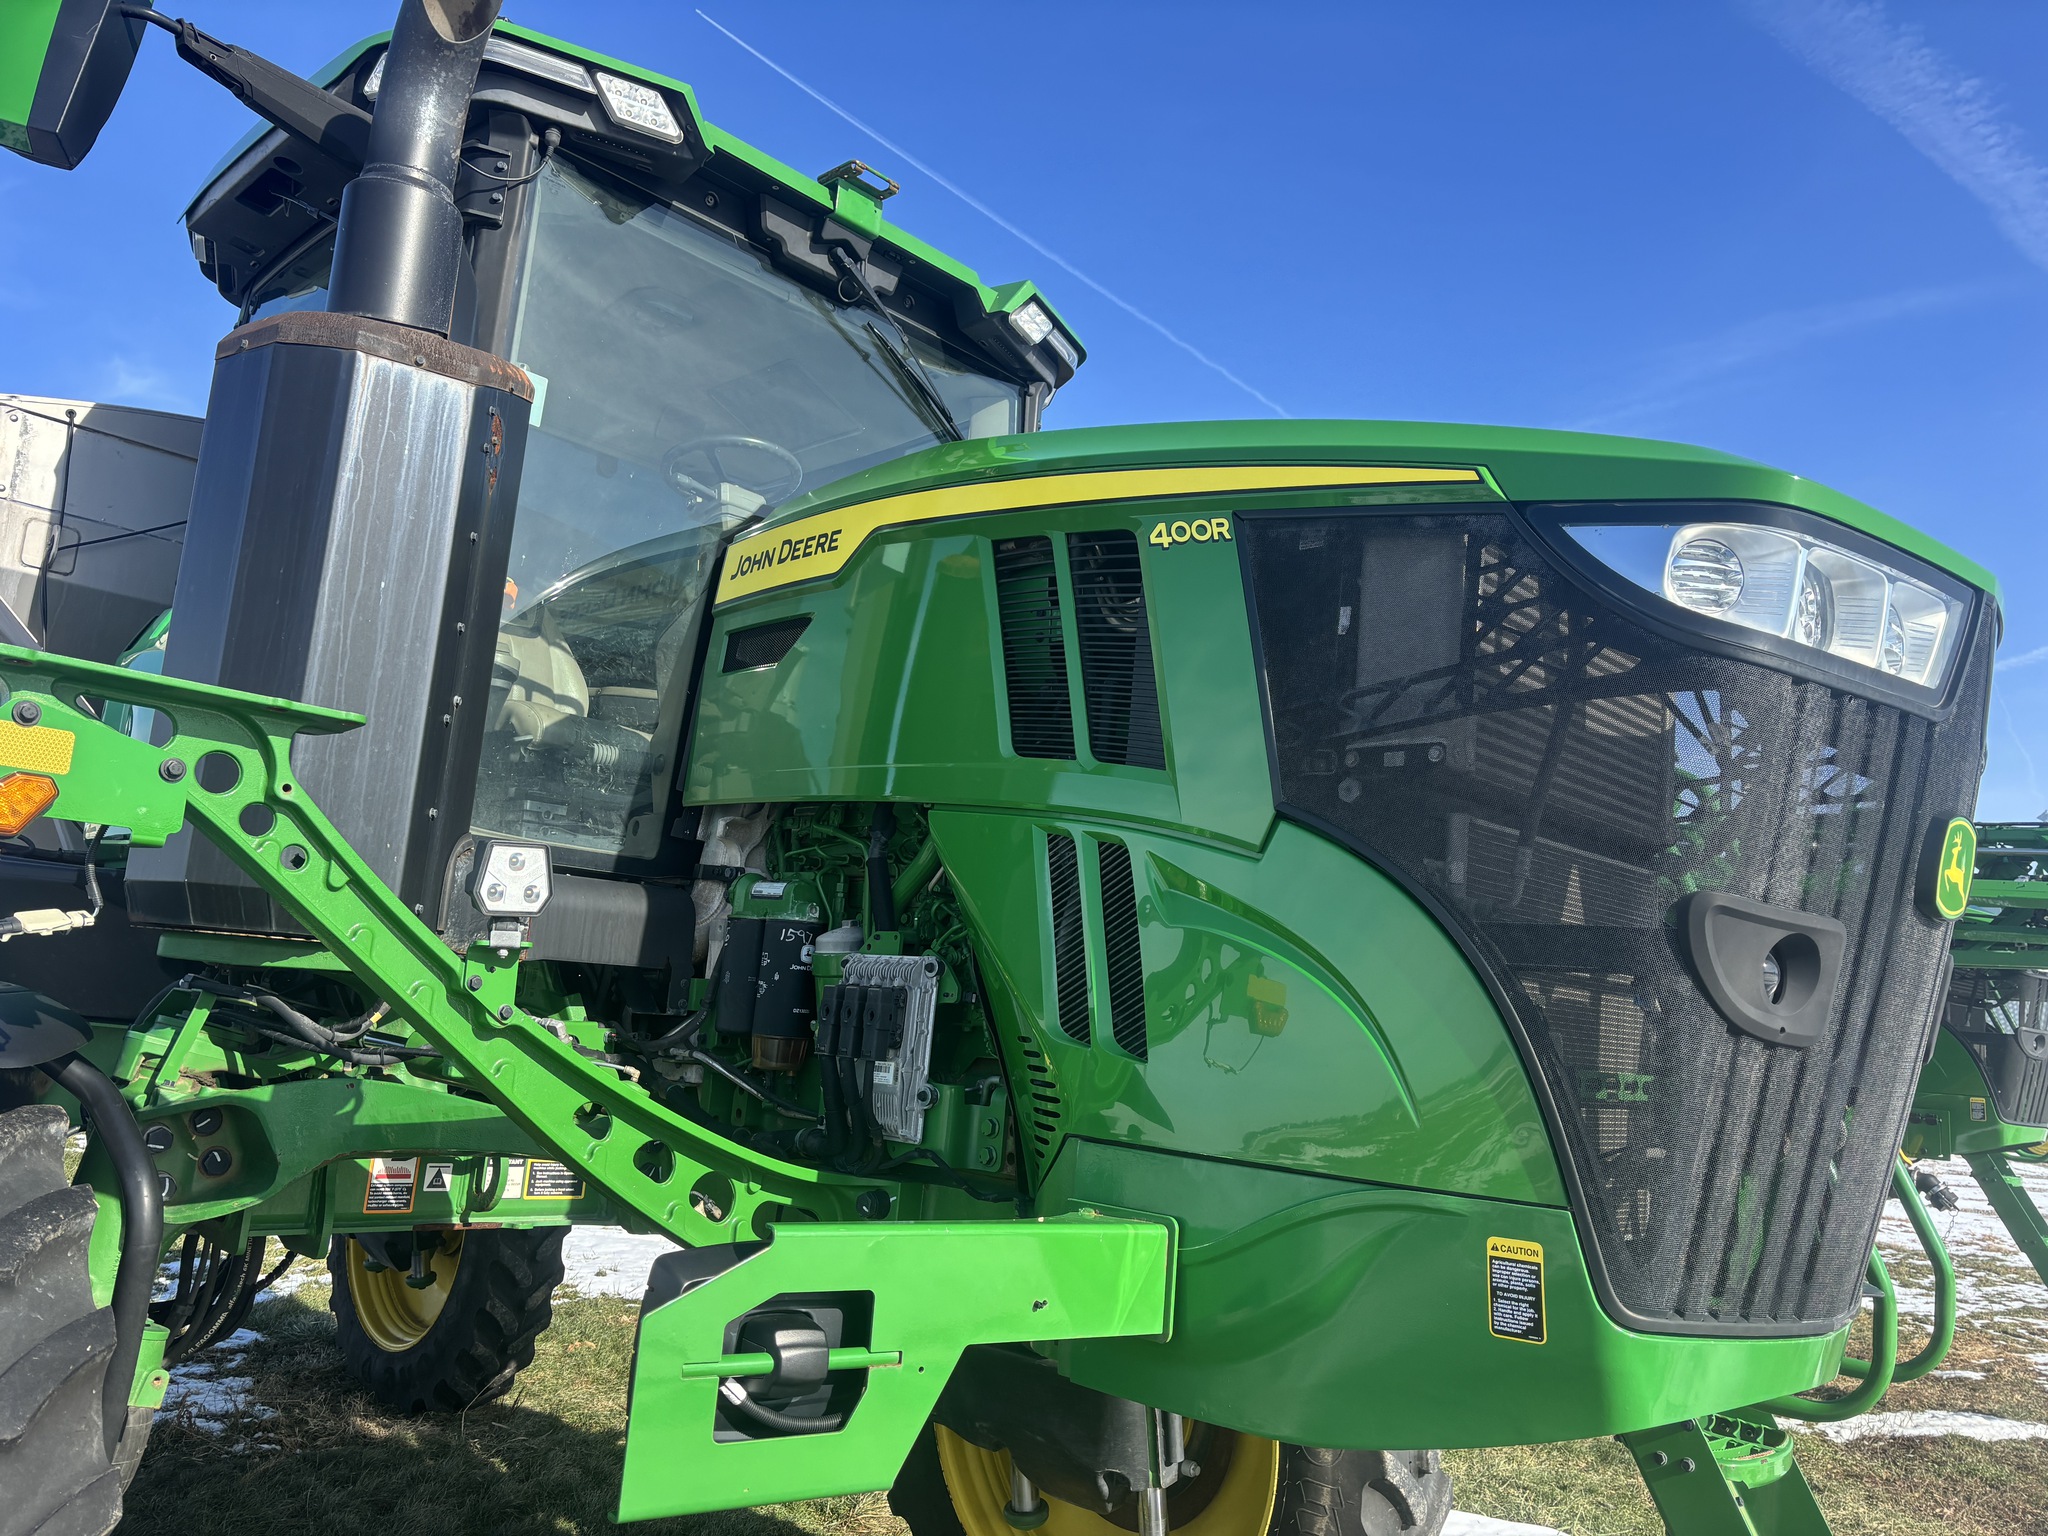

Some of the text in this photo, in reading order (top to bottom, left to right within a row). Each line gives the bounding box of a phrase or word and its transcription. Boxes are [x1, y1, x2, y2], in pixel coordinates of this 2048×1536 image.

[1149, 516, 1232, 550] 400R
[730, 528, 843, 581] JOHN DEERE
[1500, 1244, 1539, 1258] CAUTION
